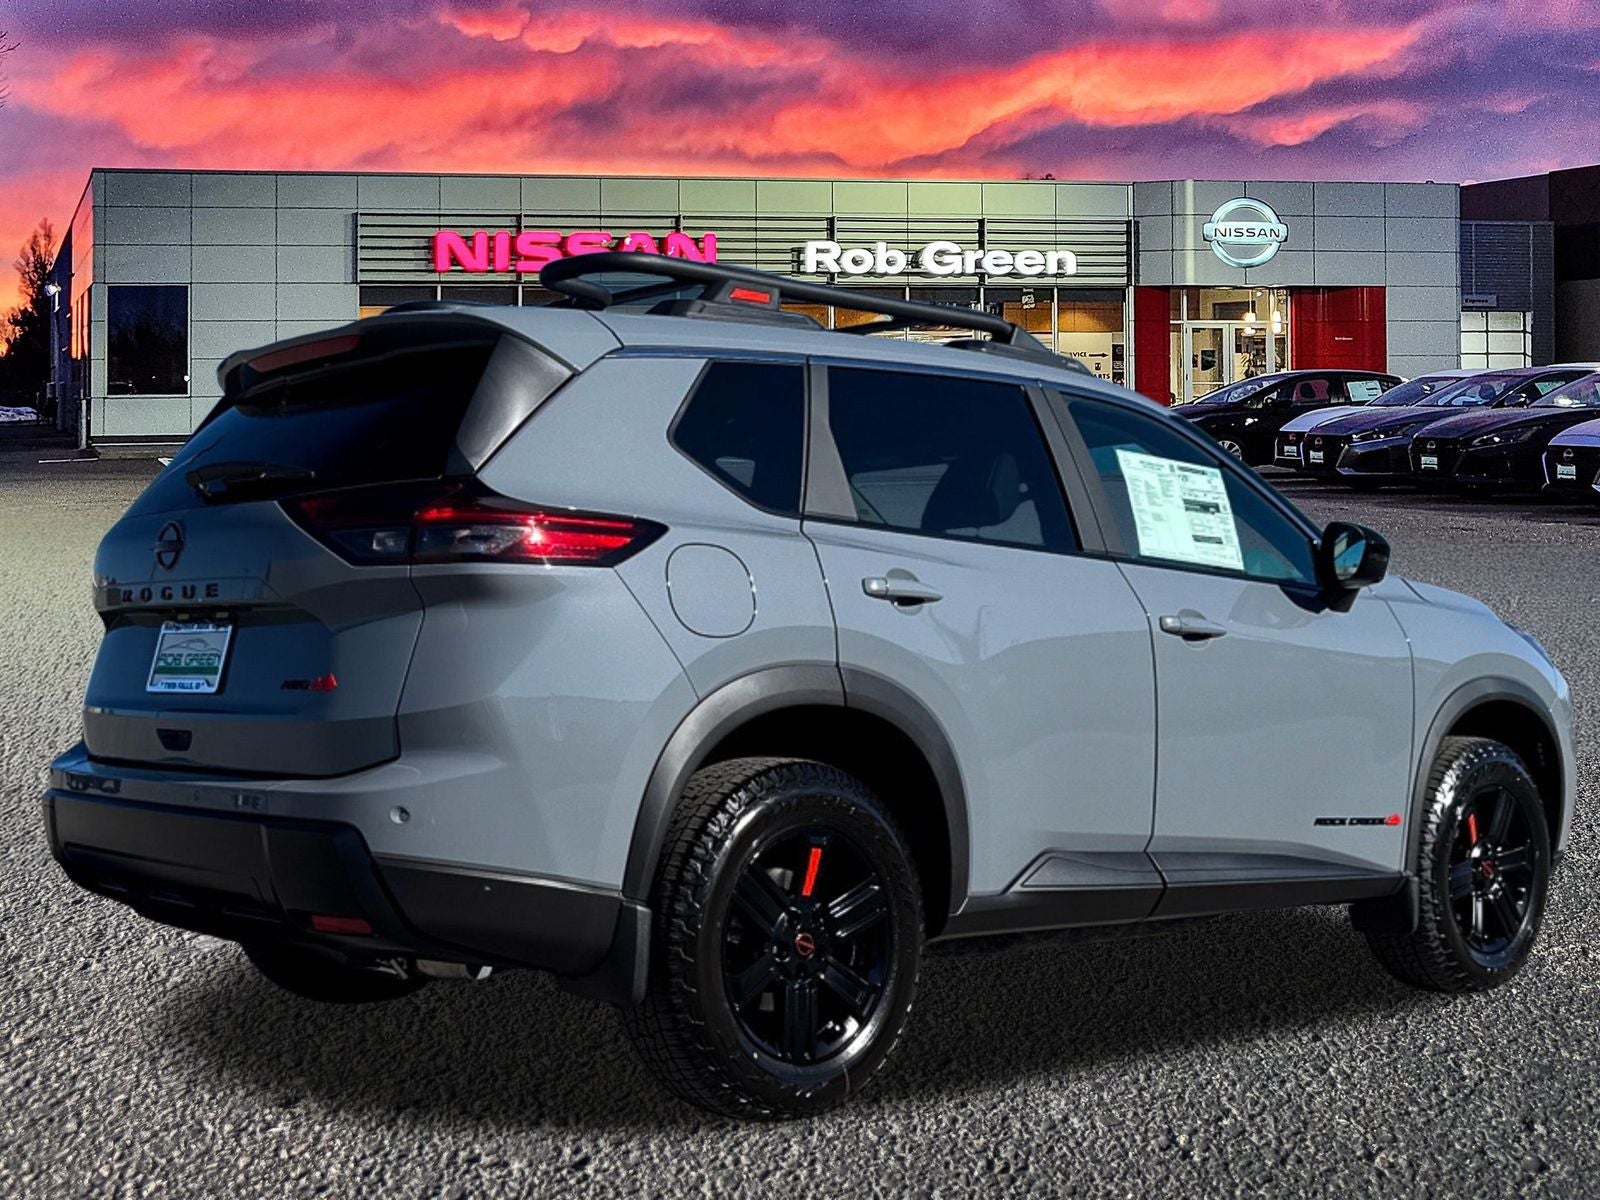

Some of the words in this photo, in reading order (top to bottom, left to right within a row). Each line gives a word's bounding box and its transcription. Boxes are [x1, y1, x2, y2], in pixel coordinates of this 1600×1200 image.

[1214, 228, 1280, 237] NISSAN
[805, 240, 907, 274] Rob
[920, 240, 1077, 275] Green
[122, 583, 219, 603] ROGUE
